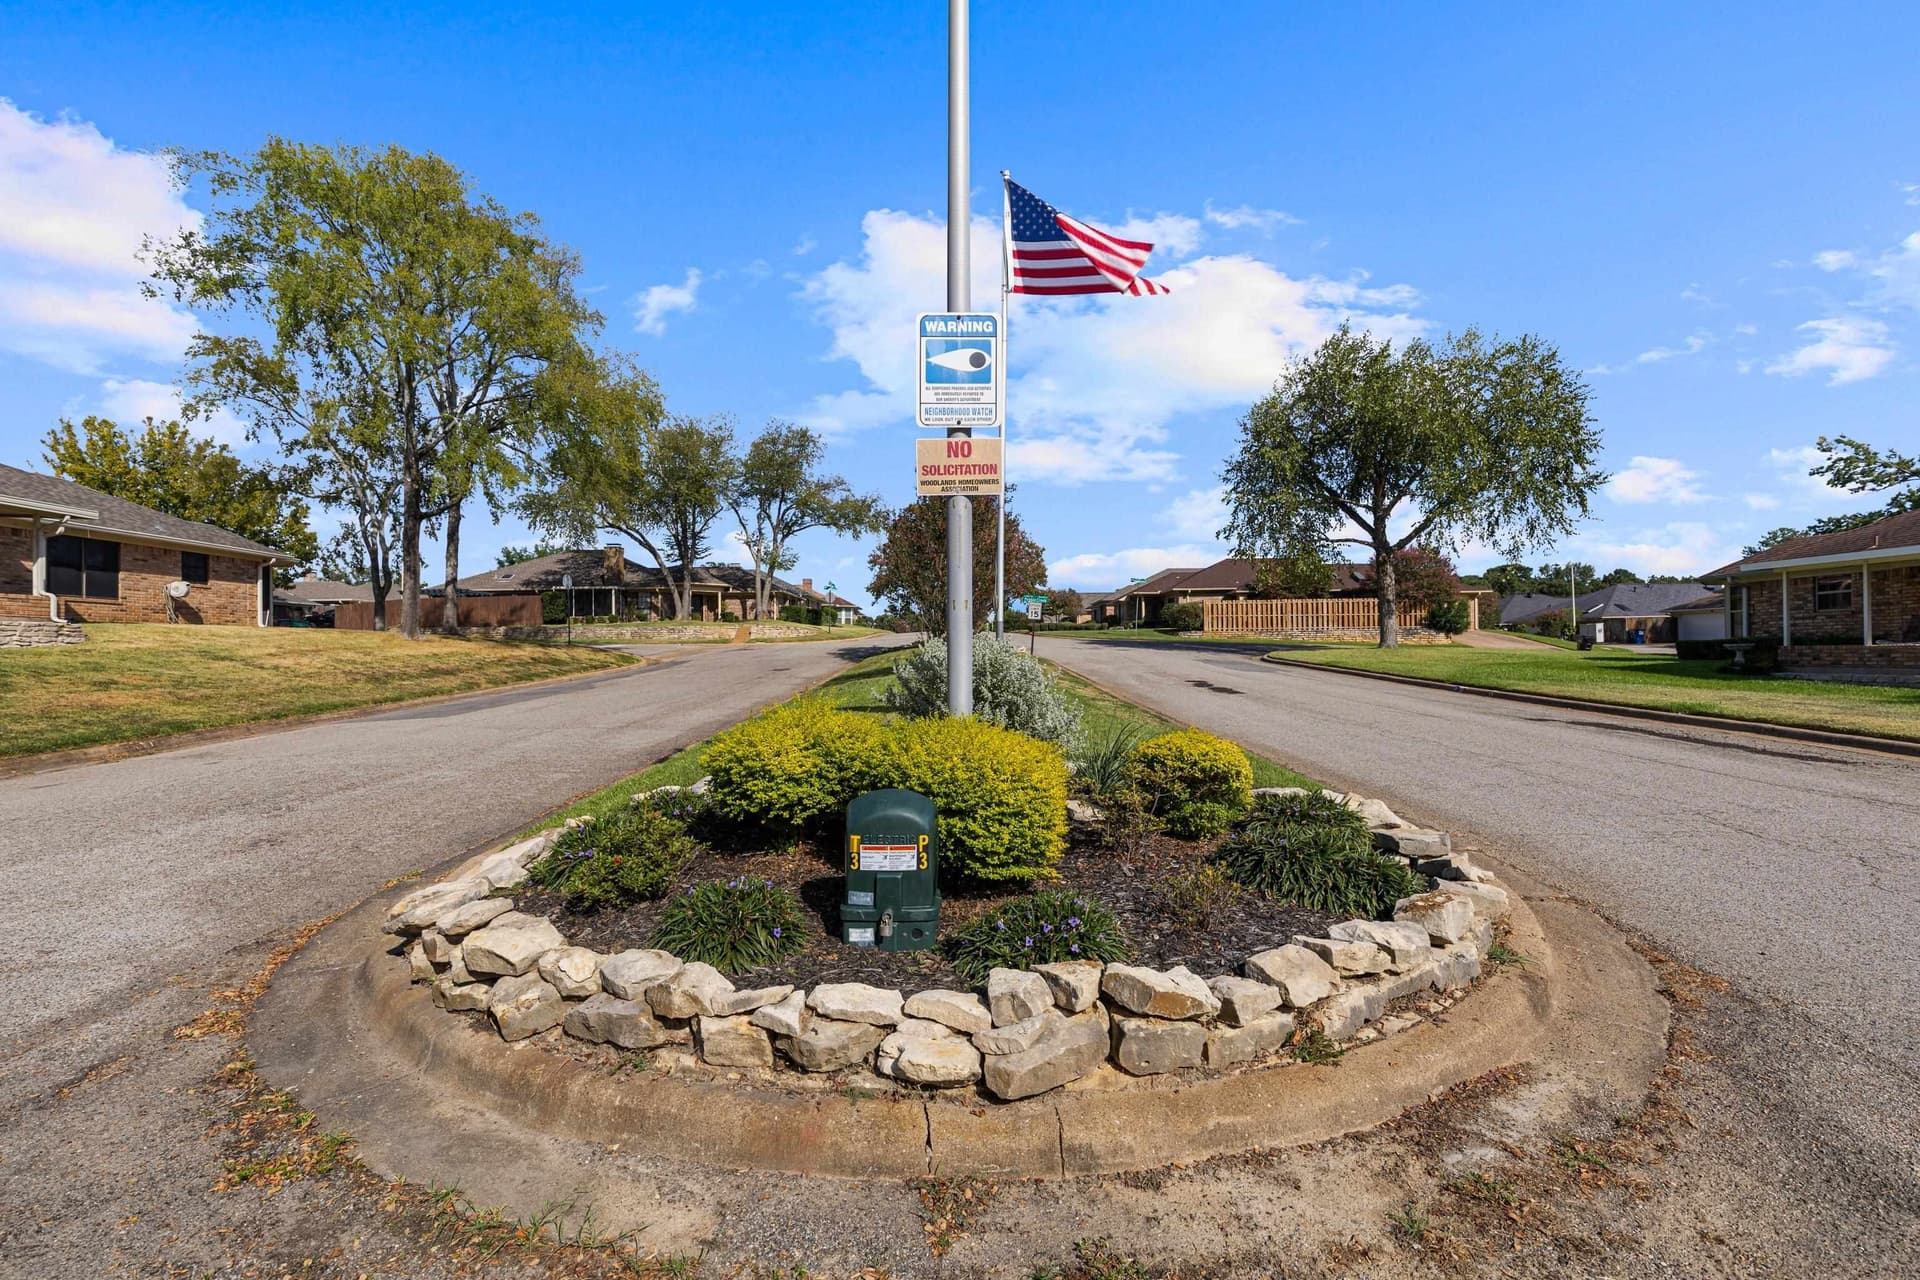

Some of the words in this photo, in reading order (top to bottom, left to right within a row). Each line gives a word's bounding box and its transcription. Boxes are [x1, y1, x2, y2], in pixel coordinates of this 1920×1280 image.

[925, 321, 993, 333] WARNING
[925, 407, 971, 416] NEIGHBORHOOD
[972, 407, 993, 416] WATCH
[947, 441, 972, 458] NO
[921, 464, 998, 476] SOLICITATION
